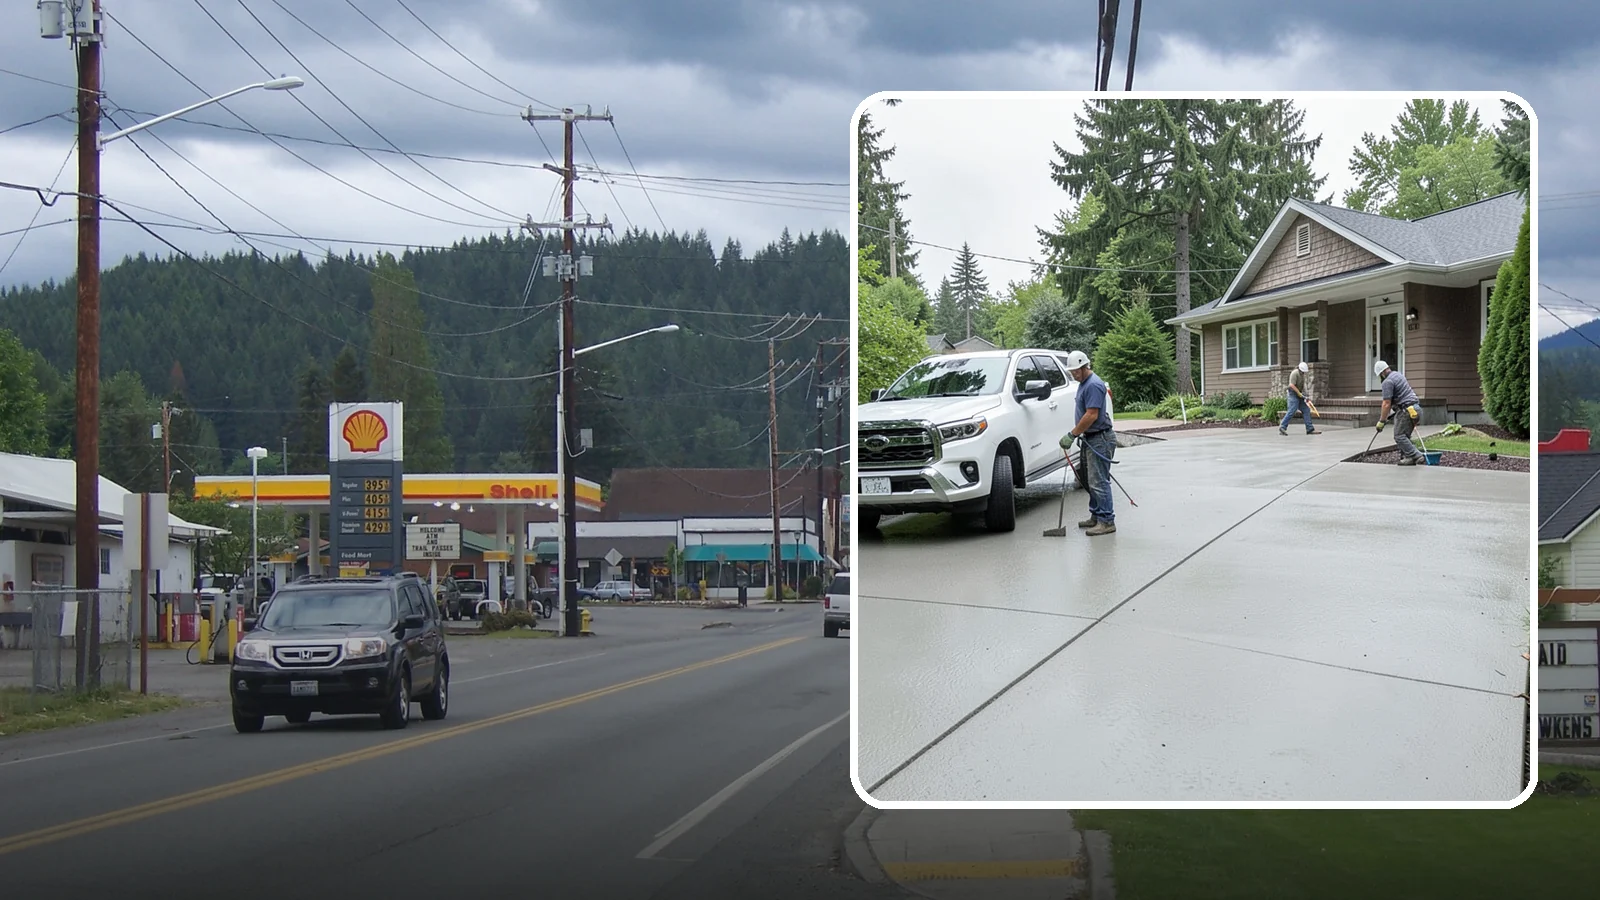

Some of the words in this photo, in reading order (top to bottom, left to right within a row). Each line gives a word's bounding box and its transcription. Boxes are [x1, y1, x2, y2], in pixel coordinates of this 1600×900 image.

[366, 480, 383, 490] 395
[490, 484, 547, 499] Shell
[366, 494, 383, 504] 405
[366, 508, 383, 518] 415
[366, 522, 383, 532] 429
